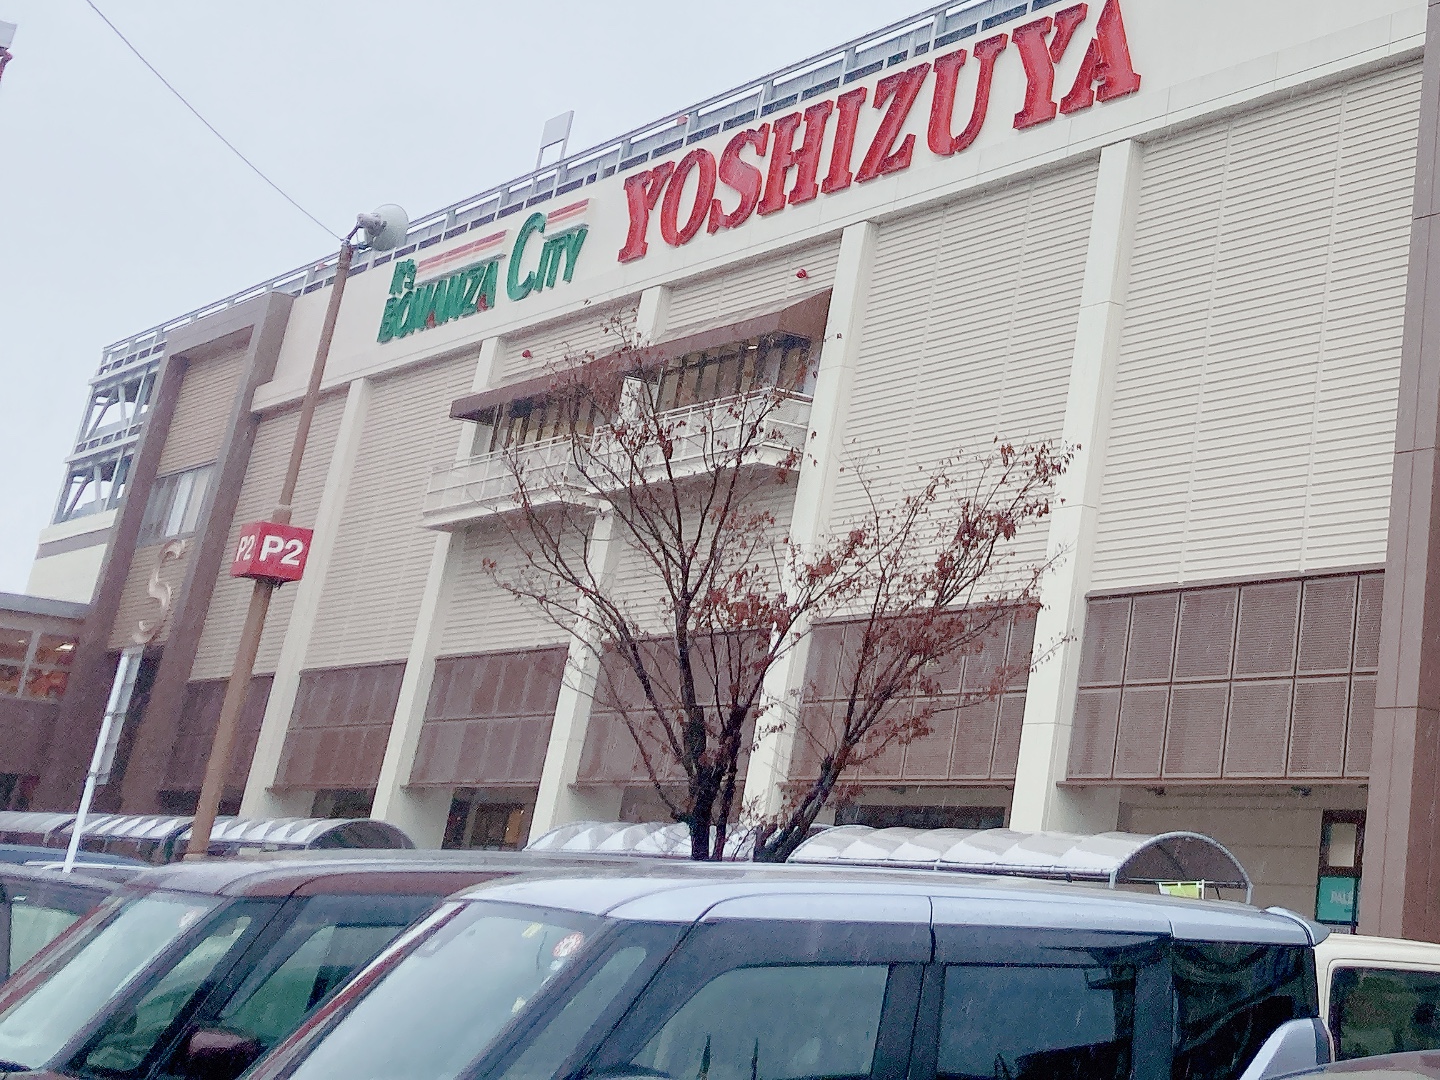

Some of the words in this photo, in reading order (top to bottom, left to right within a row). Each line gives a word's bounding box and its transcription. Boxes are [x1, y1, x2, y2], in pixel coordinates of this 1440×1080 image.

[377, 260, 499, 344] BONANZA
[235, 535, 255, 562] P2
[259, 535, 304, 566] P2
